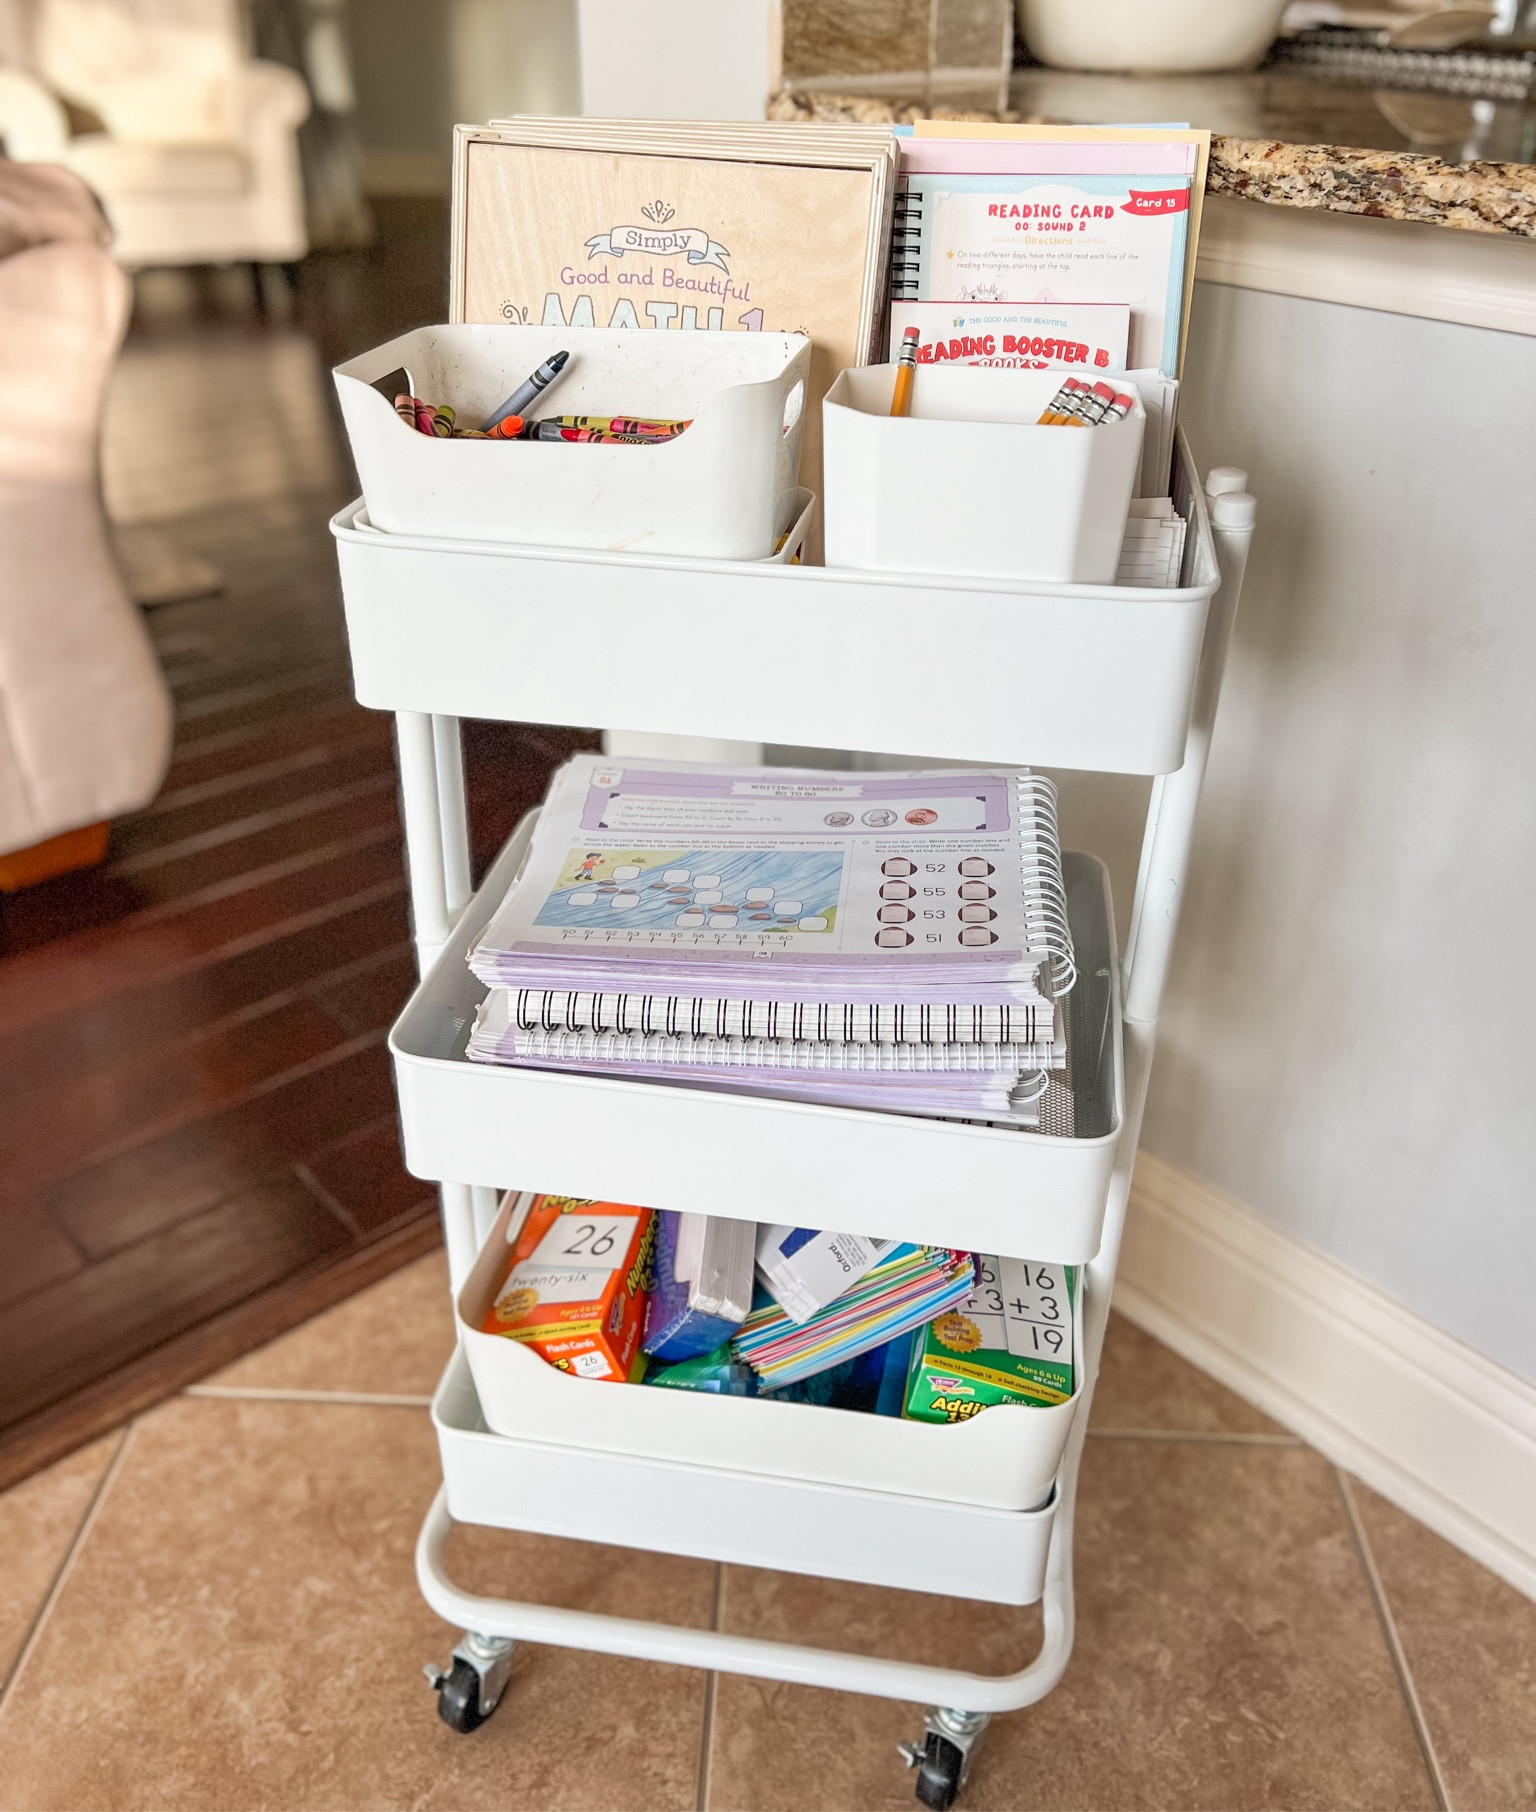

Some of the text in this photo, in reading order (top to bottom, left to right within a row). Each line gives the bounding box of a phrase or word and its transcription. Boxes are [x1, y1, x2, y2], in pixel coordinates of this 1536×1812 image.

[1136, 197, 1176, 207] Card 15
[988, 203, 1115, 220] READING CARD
[1037, 221, 1074, 232] SOUND
[1078, 221, 1086, 231] 2
[625, 230, 692, 251] Simply
[1024, 235, 1073, 245] Directions
[957, 250, 968, 258] On
[969, 251, 982, 259] two
[983, 251, 1010, 259] different
[1012, 251, 1028, 261] days,
[1030, 251, 1044, 259] have
[1058, 252, 1073, 260] child
[1074, 252, 1089, 260] read
[957, 262, 981, 271] reading
[982, 262, 1011, 272] triangles,
[1013, 263, 1038, 272] starting
[1060, 264, 1072, 272] top.
[560, 265, 750, 304] Good and Beautiful
[969, 317, 981, 325] THE
[983, 316, 1002, 324] GOOD
[1004, 316, 1019, 324] AND
[1033, 318, 1069, 328] BEAUTIFUL
[1003, 334, 1090, 364] BOOSTER
[1094, 348, 1110, 368] B
[925, 864, 947, 873] 52
[923, 888, 946, 897] 55
[923, 910, 946, 920] 53
[926, 934, 943, 943] 51
[562, 1224, 618, 1256] 26
[828, 1245, 851, 1273] Oxford
[511, 1271, 589, 1287] twenty-six
[1023, 1264, 1055, 1290] 16
[986, 1289, 1004, 1311] 3
[1041, 1296, 1060, 1321] 3
[944, 1325, 970, 1336] Building
[949, 1319, 963, 1327] Skill
[545, 1338, 596, 1354] Flash Cards
[944, 1334, 974, 1345] Test Prep
[1032, 1326, 1064, 1354] 19
[581, 1355, 598, 1367] 26
[940, 1360, 954, 1368] Facts
[962, 1366, 984, 1378] through
[1017, 1363, 1038, 1377] Ages
[1054, 1373, 1066, 1384] Up
[1004, 1378, 1061, 1400] Self-checking Design
[1033, 1375, 1063, 1389] 99 Cards
[930, 1397, 988, 1416] Addit
[949, 1412, 970, 1423] 13
